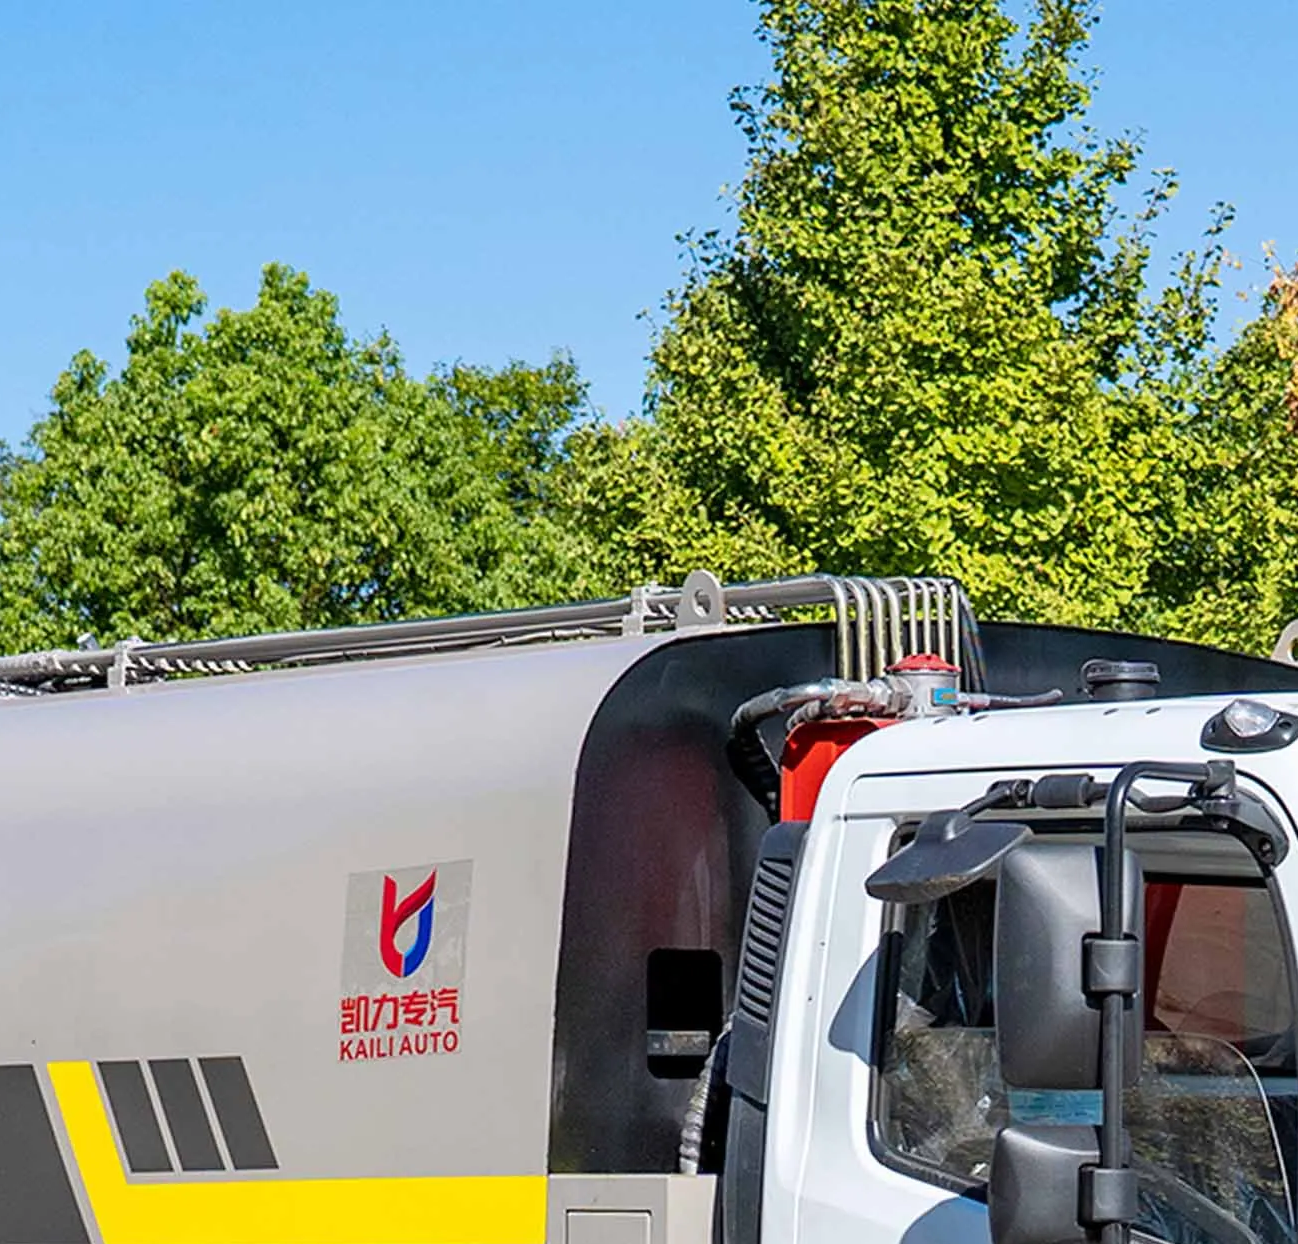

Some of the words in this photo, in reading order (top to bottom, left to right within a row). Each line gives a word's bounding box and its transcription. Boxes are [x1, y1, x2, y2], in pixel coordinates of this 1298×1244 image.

[341, 988, 460, 1035] 凯力专汽
[339, 1036, 395, 1061] KAILI
[399, 1030, 459, 1056] AUTO
